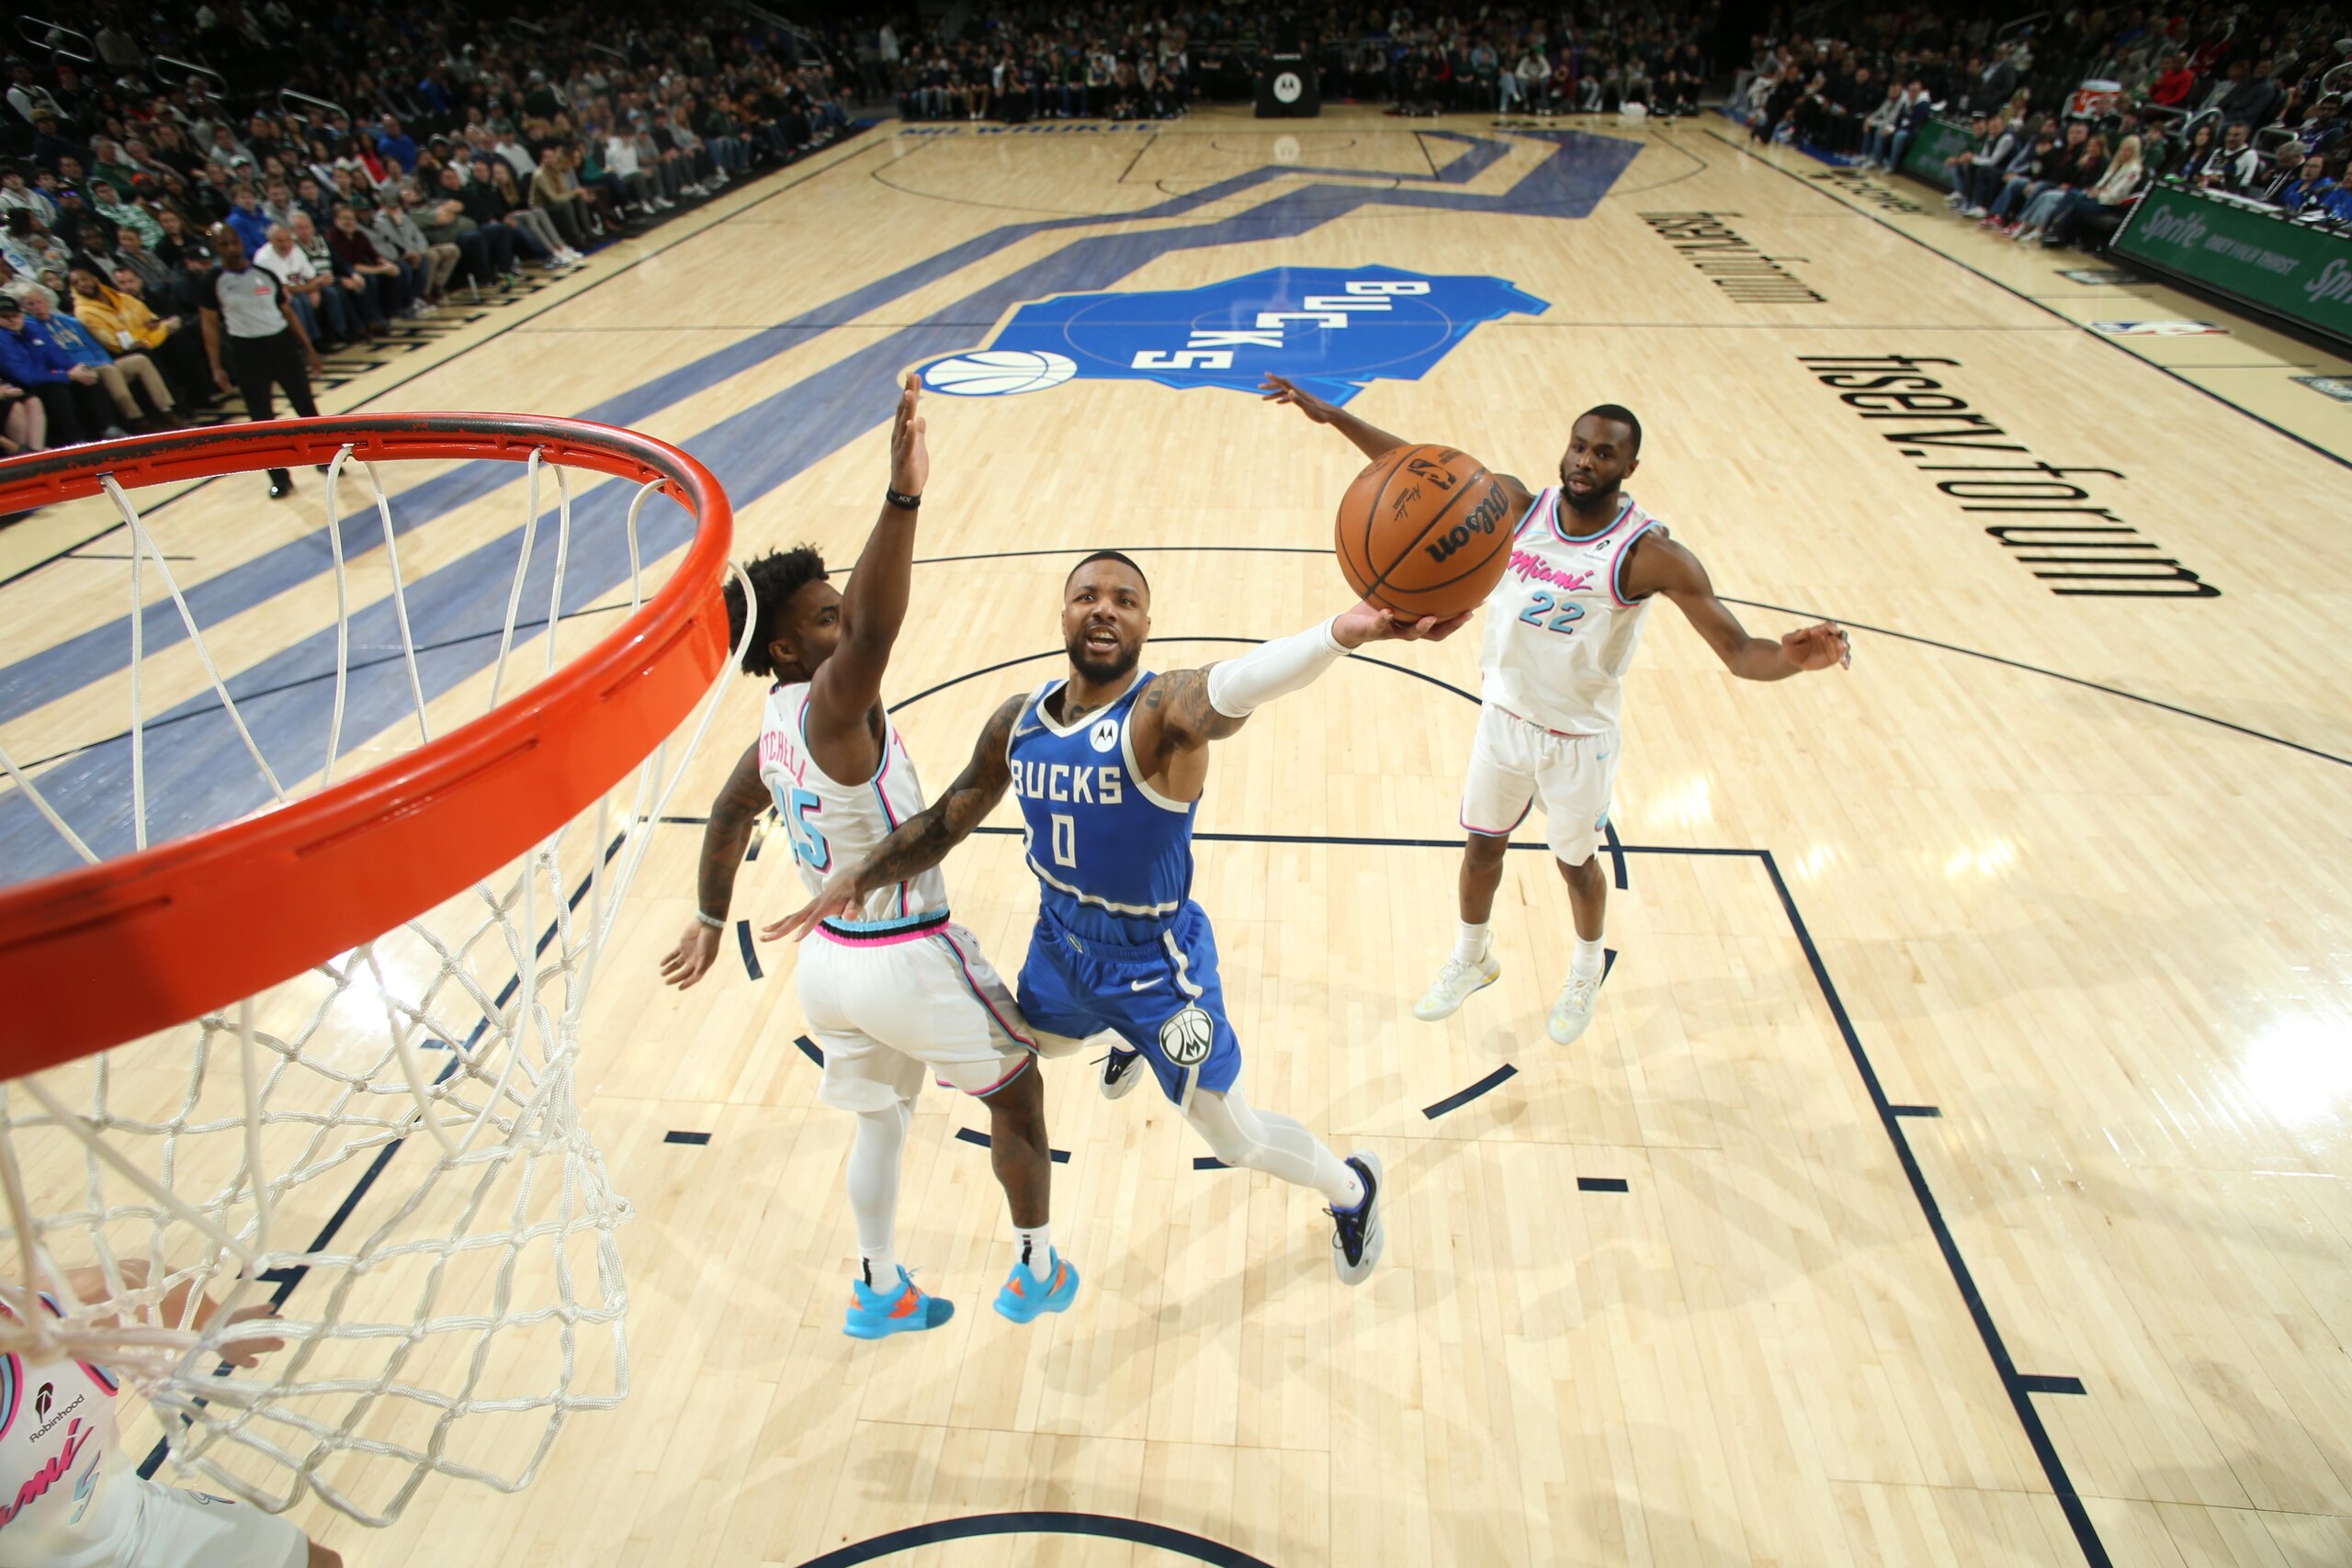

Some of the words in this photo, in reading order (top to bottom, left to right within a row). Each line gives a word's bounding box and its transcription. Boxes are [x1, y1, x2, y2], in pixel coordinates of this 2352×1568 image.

[2140, 204, 2207, 249] Sprite
[1131, 280, 1430, 368] BUCKS
[1425, 479, 1510, 563] Wilson
[1508, 550, 1595, 592] Miami
[1519, 591, 1585, 635] 22
[757, 730, 807, 788] ITCHELL
[1011, 759, 1123, 805] BUCKS
[1051, 813, 1077, 869] 0
[28, 1393, 85, 1444] Robinhood
